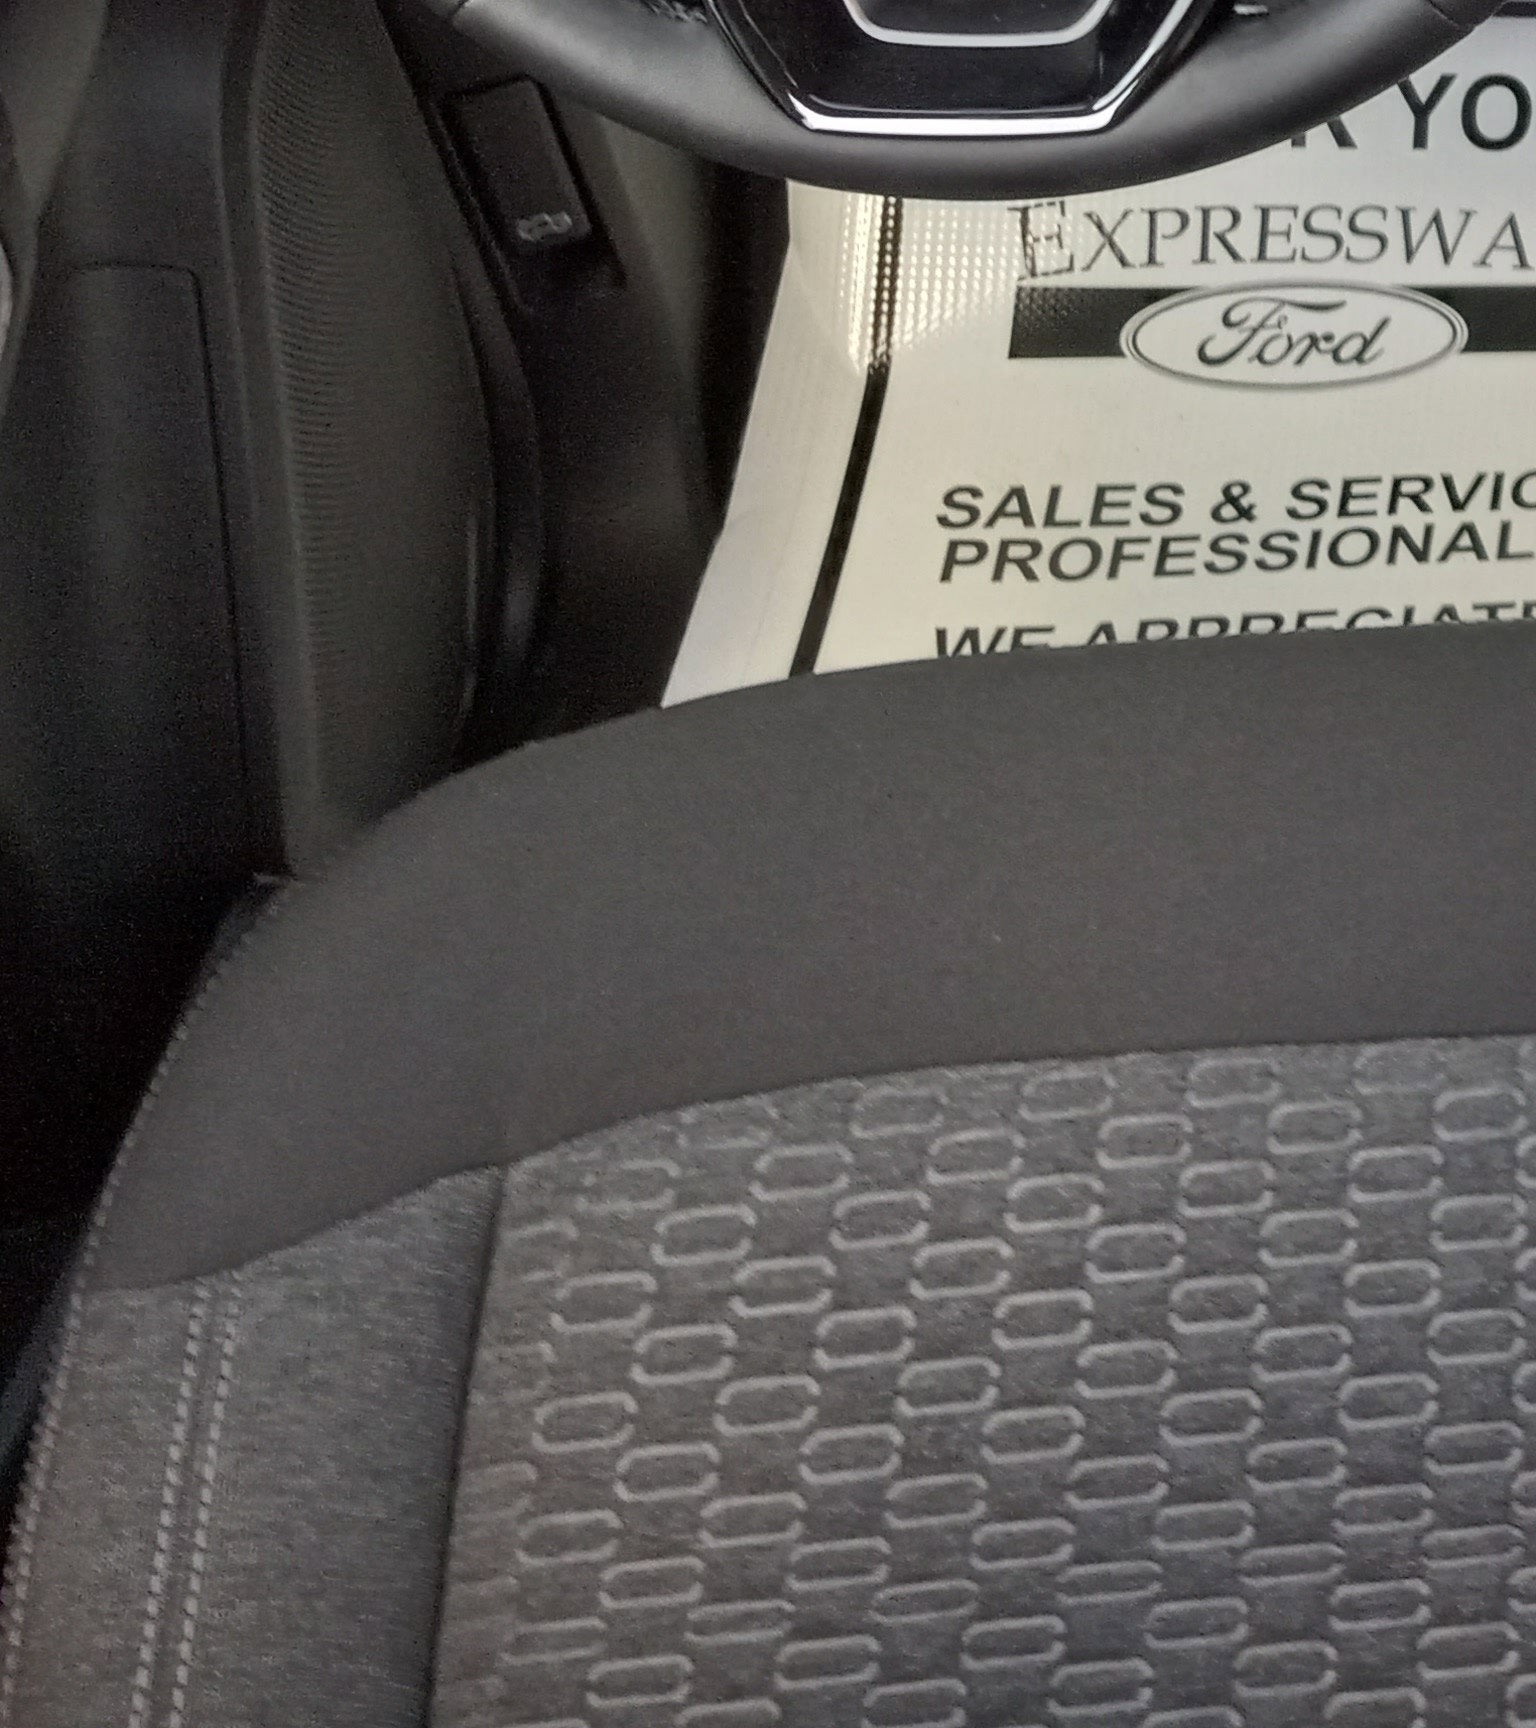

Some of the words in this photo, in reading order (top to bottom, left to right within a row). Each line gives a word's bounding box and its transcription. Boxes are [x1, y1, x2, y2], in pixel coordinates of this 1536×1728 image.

[1197, 295, 1392, 367] Ford
[935, 482, 1187, 530] SALES
[1209, 480, 1257, 525] &
